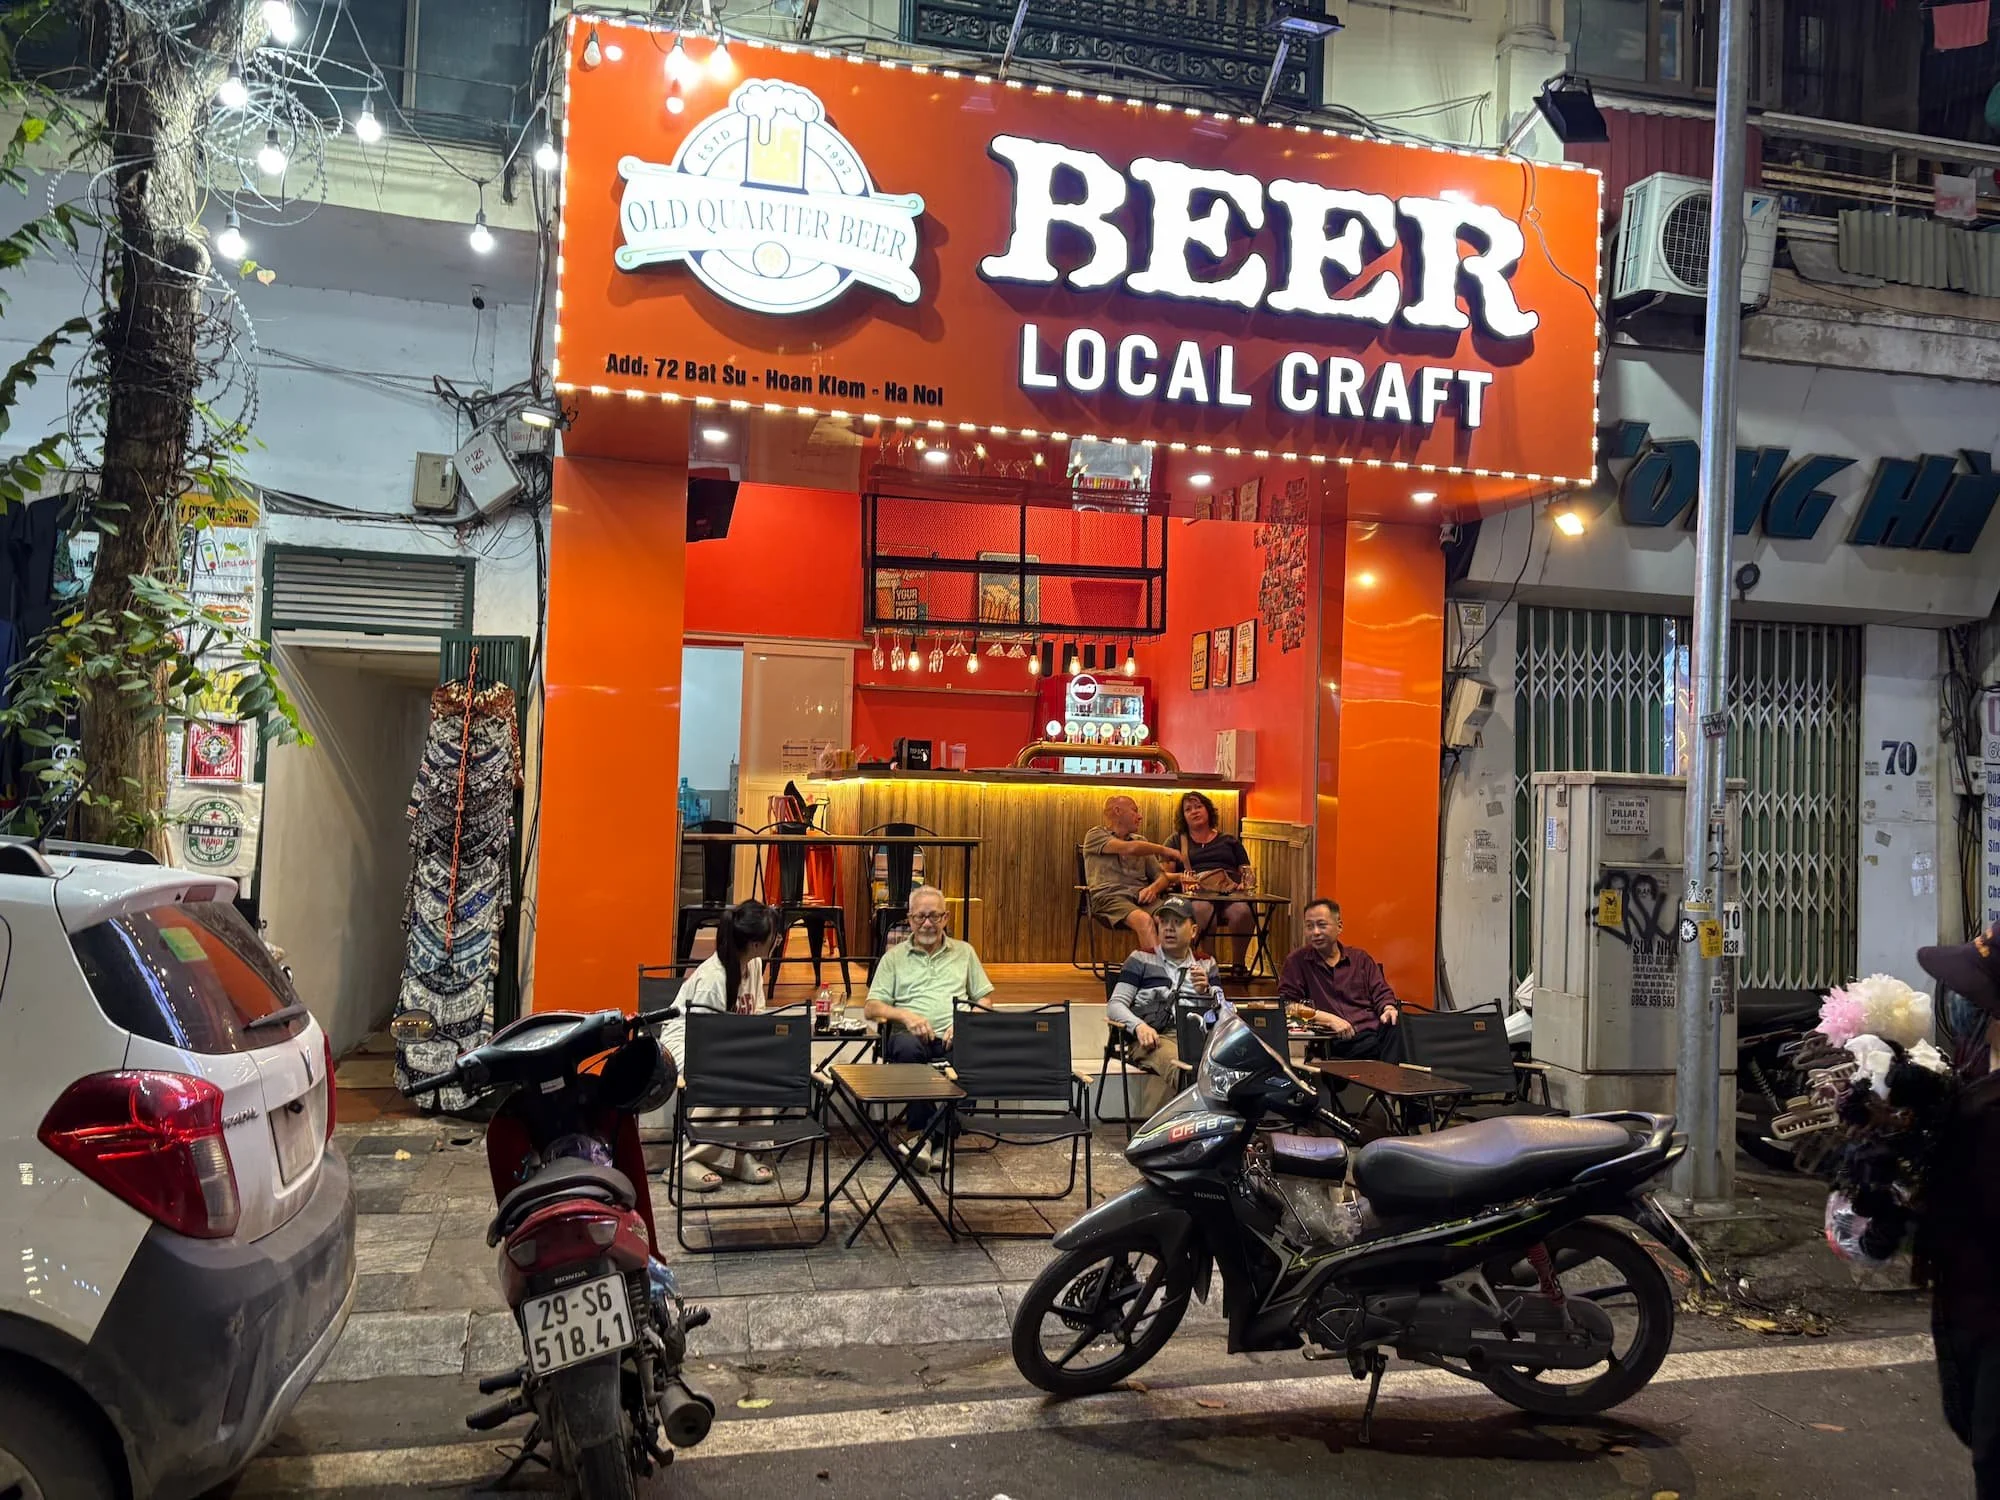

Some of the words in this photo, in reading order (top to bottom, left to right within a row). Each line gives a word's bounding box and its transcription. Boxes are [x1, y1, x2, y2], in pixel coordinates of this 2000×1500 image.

[824, 143, 852, 176] 1992
[627, 199, 689, 234] OLD
[696, 197, 831, 242] QUARTER
[838, 214, 907, 262] BEER
[977, 132, 1540, 338] BEER
[605, 352, 648, 377] Add:
[655, 358, 678, 379] 72
[685, 361, 716, 385] Bat
[722, 365, 746, 387] Su
[766, 369, 812, 394] Hoan
[885, 381, 908, 405] Ha
[1019, 322, 1253, 407] LOCAL
[1279, 350, 1493, 428] CRAFT
[896, 588, 918, 600] YOUR
[896, 607, 917, 621] PUB
[1881, 740, 1917, 776] 70
[1193, 1191, 1225, 1201] HONDA
[554, 1270, 588, 1284] HONDA
[538, 1282, 612, 1331] 29-S6
[534, 1312, 626, 1369] 518.41
